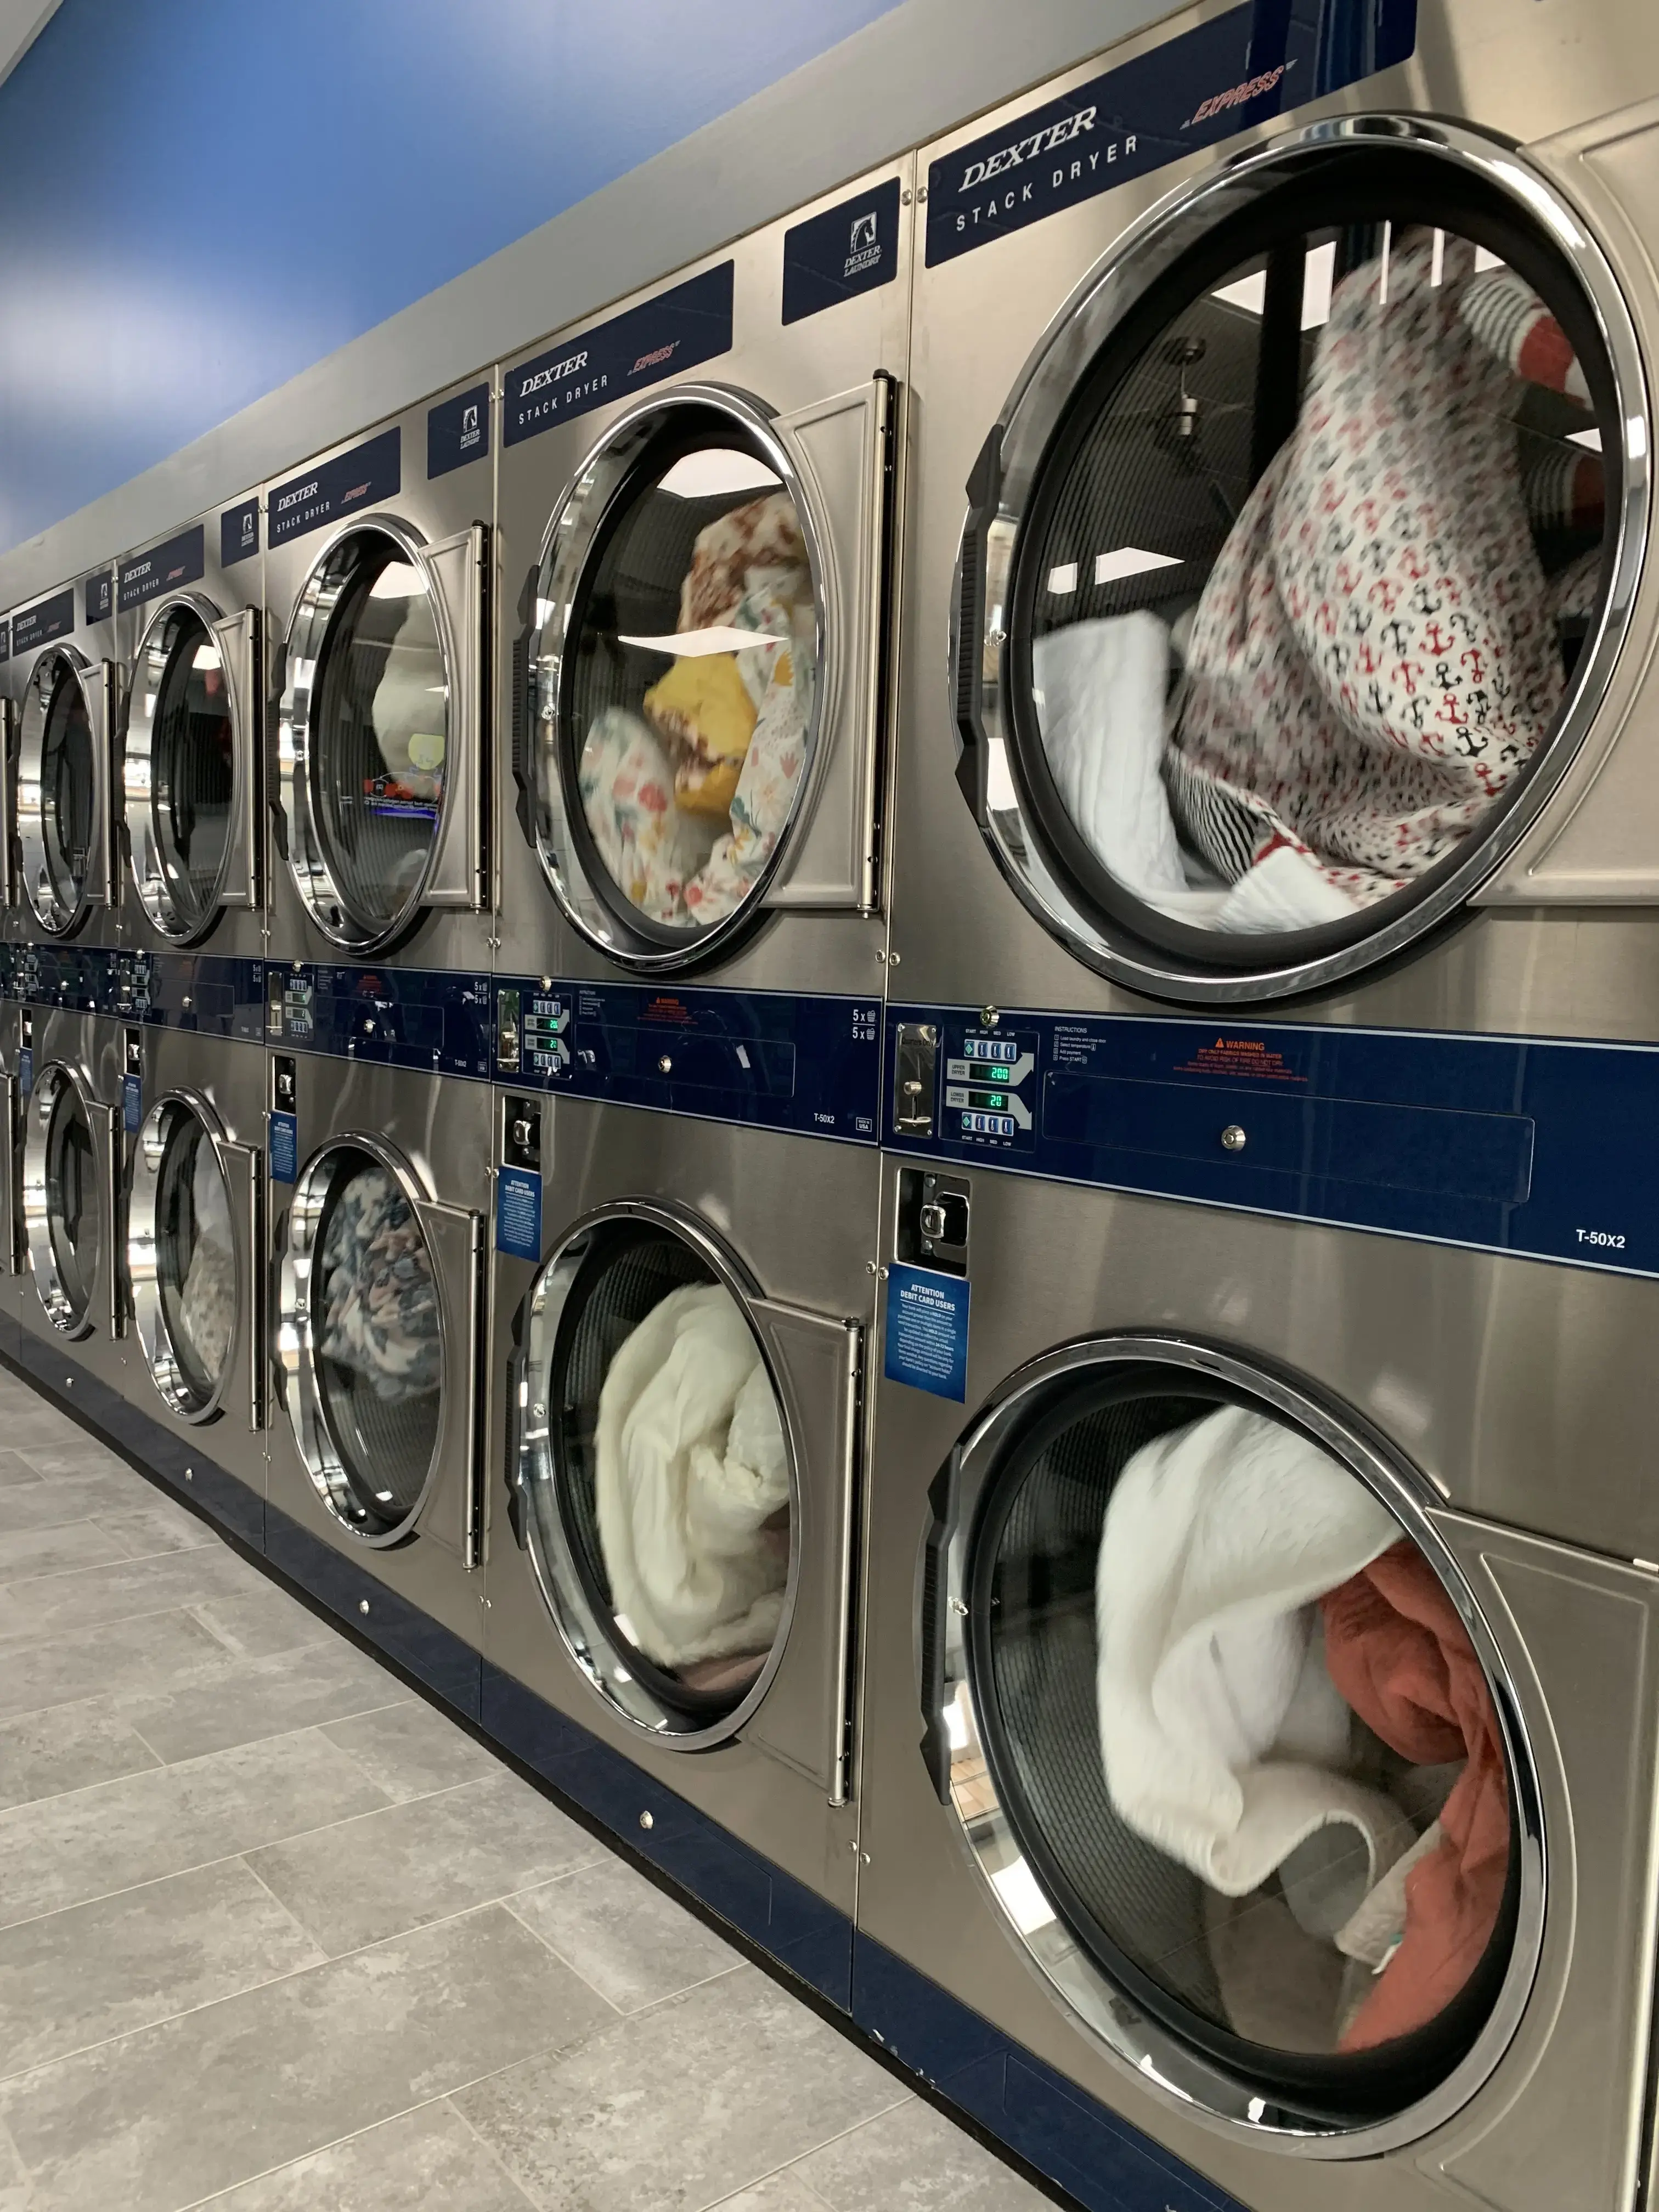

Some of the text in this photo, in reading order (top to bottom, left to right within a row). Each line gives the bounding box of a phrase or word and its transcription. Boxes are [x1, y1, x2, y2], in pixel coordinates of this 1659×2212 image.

[1191, 65, 1284, 125] EXPRESS
[958, 105, 1097, 192] DEXTER
[957, 135, 1136, 231] STACK DRYER
[844, 245, 881, 268] DEXTER
[520, 351, 588, 397] DEXTER
[519, 375, 607, 425] STACK DRYER
[277, 482, 318, 512] DEXTER
[276, 501, 330, 533] STACK DRYER
[124, 562, 151, 584] DEXTER
[853, 1009, 859, 1022] 5
[853, 1026, 865, 1040] 5 x
[1226, 1041, 1265, 1051] WARNING
[992, 1068, 1008, 1079] 200
[991, 1096, 1001, 1107] 20
[814, 1113, 834, 1124] T-50X2
[1576, 1229, 1626, 1248] T-50X2
[900, 1290, 955, 1311] DEBIT CARD USERS
[911, 1284, 944, 1299] ATTENTION
